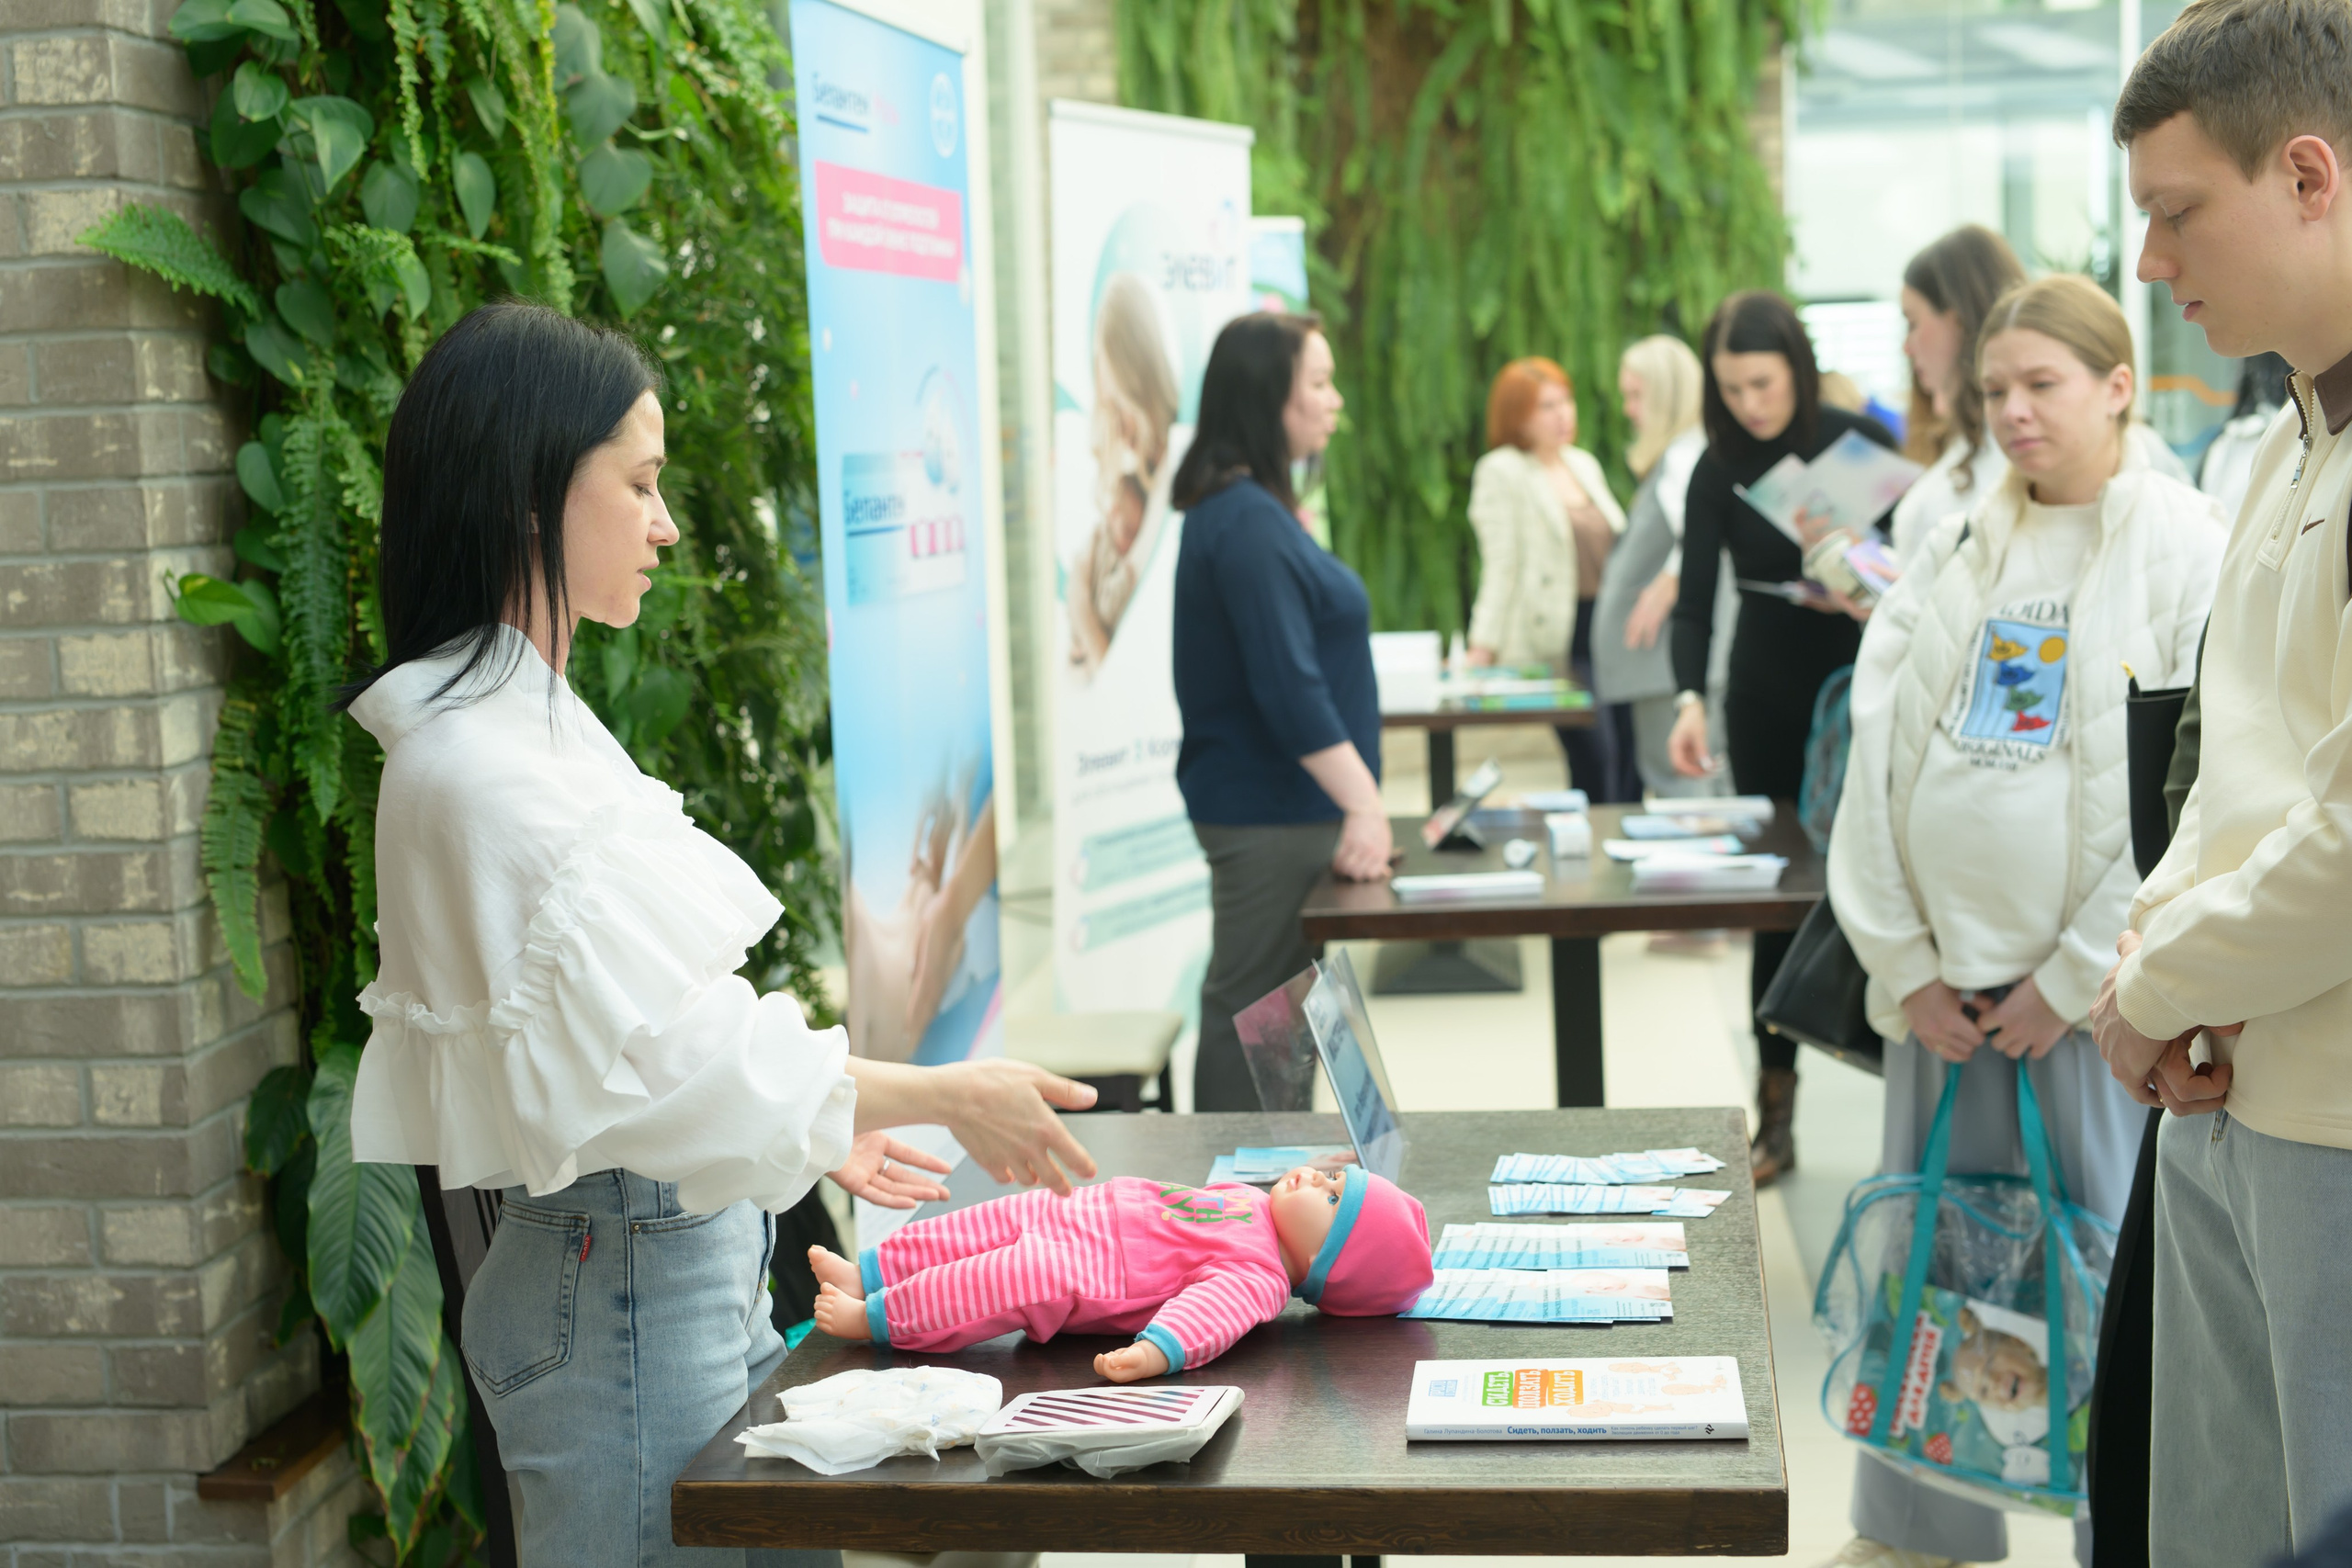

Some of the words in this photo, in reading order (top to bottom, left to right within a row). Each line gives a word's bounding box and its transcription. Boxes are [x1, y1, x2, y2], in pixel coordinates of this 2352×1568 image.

[1225, 1197, 1253, 1224] MY
[1552, 1370, 1576, 1405] ХОДИТЬ
[1507, 1426, 1540, 1435] Сидеть,
[1541, 1427, 1576, 1435] ползать,
[1577, 1427, 1607, 1435] ходить
